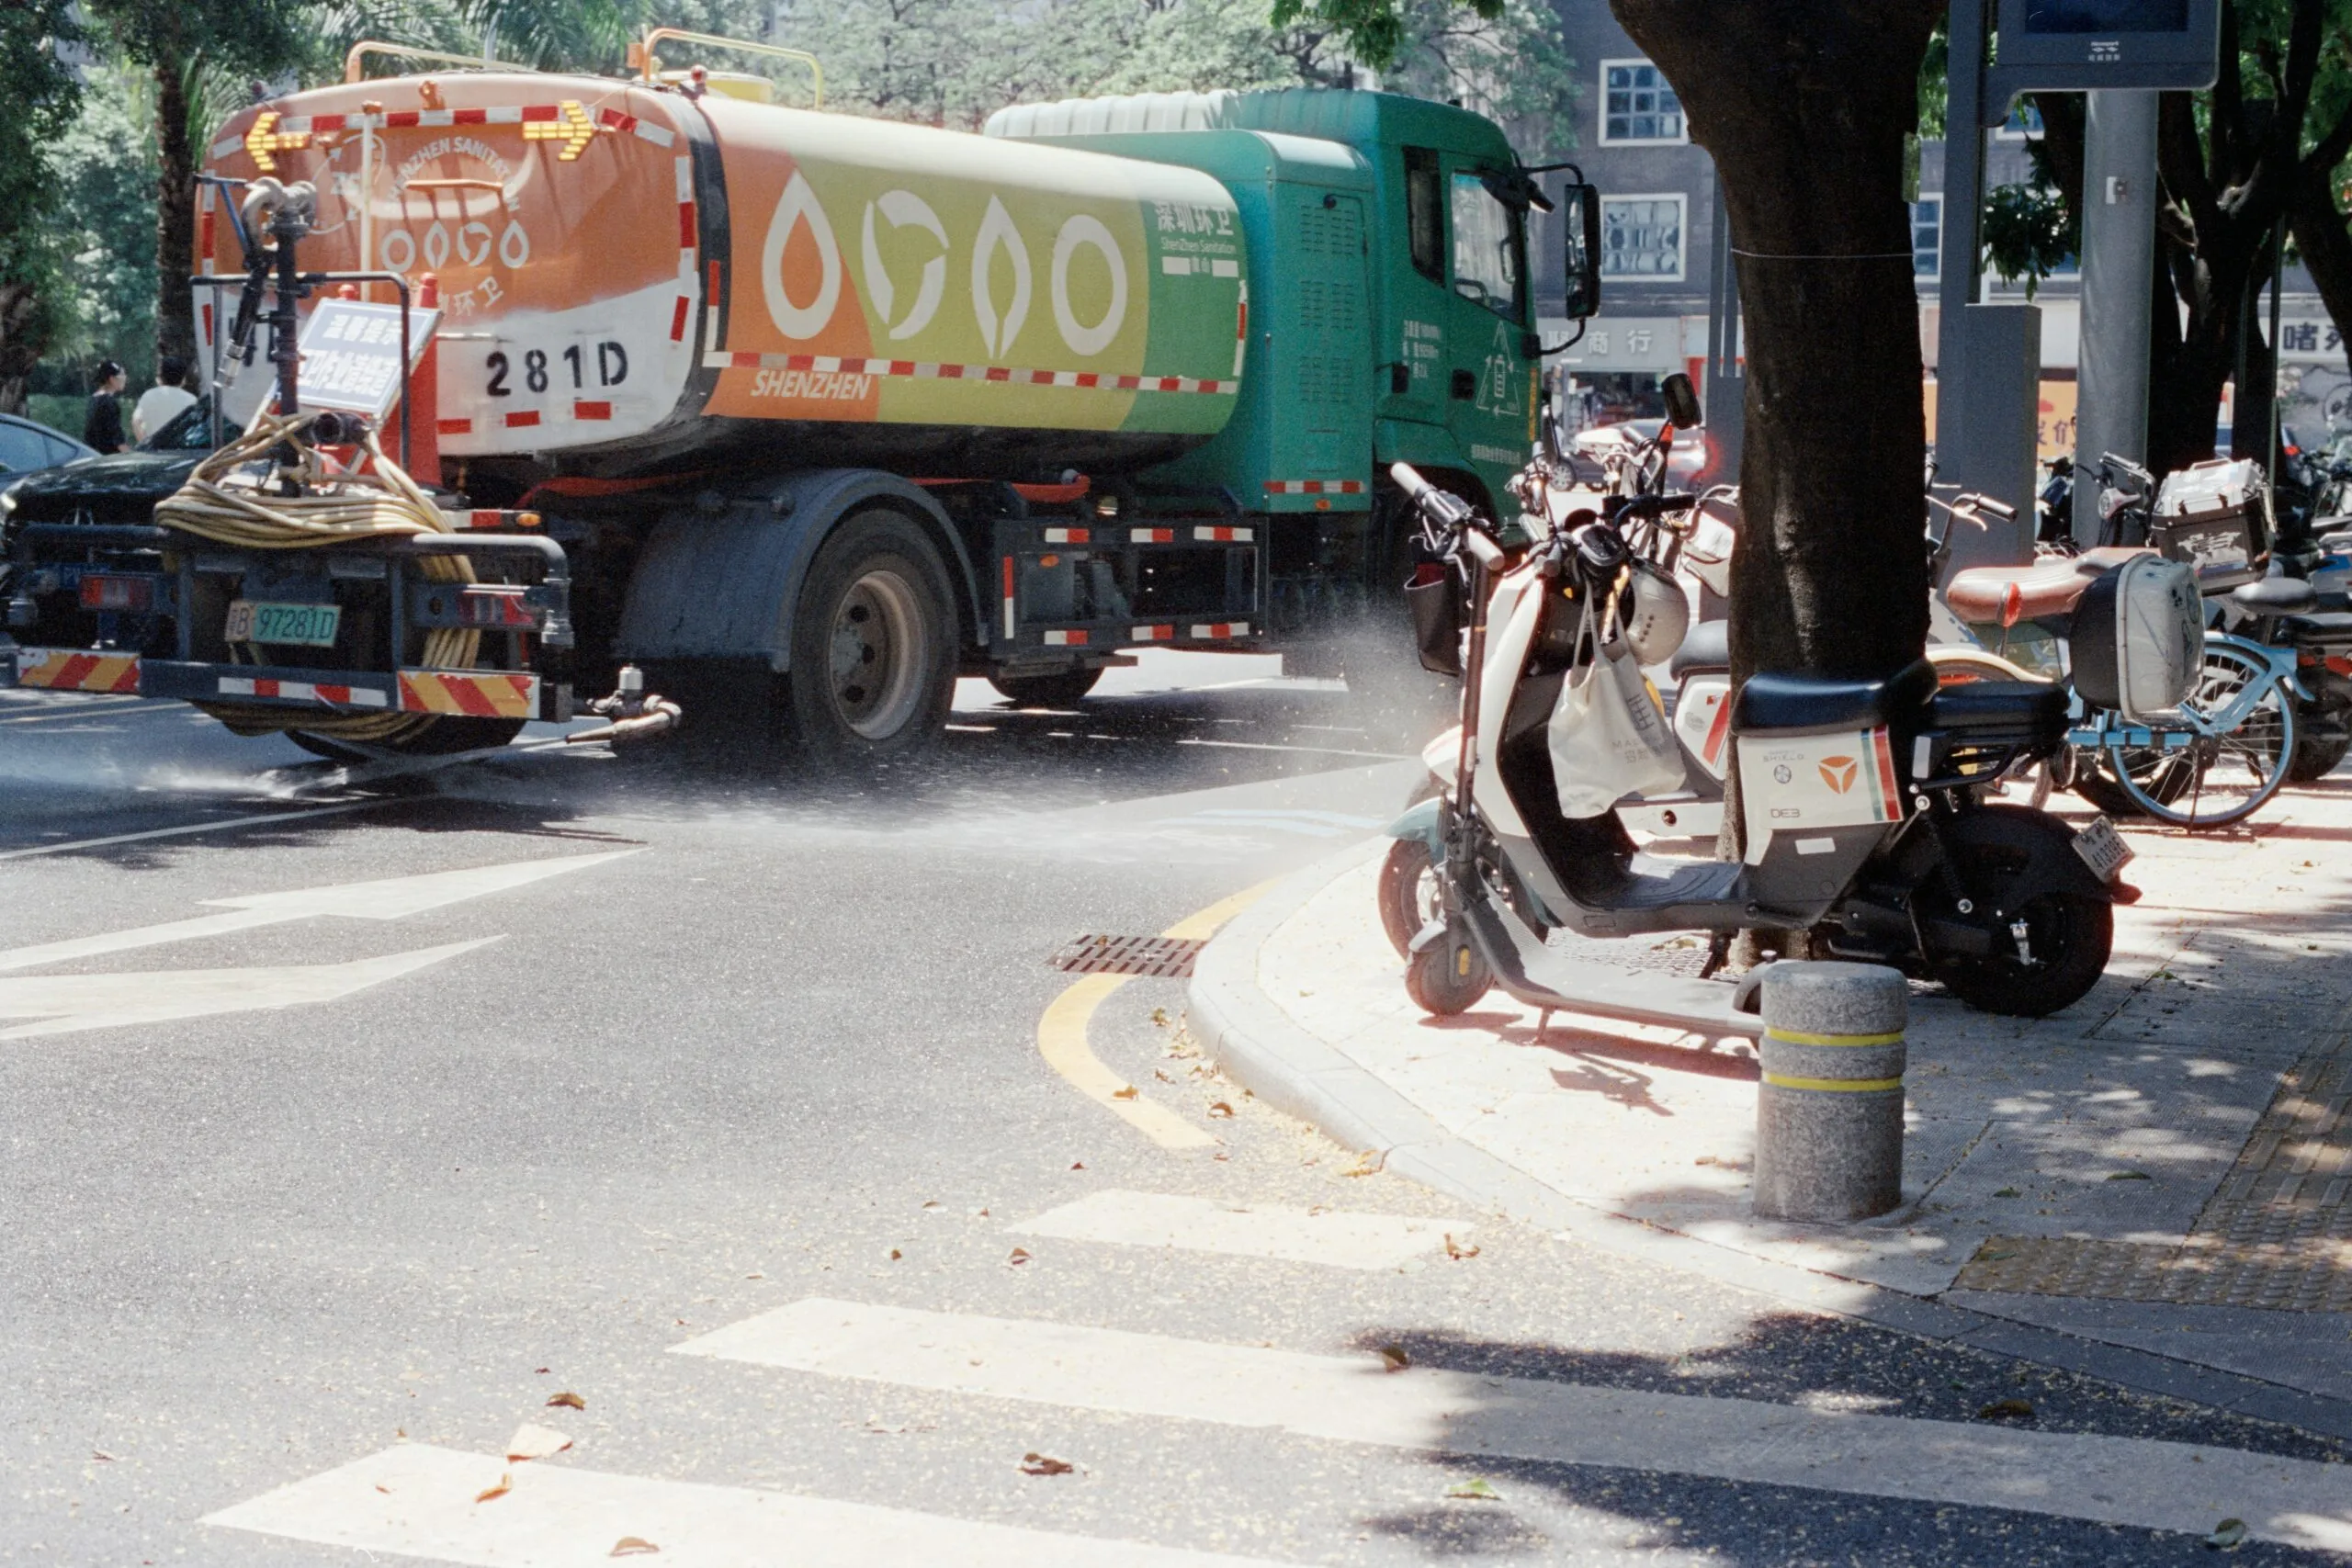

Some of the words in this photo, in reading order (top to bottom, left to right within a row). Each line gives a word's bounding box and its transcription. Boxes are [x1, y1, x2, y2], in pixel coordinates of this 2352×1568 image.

[1155, 201, 1234, 236] 深圳环卫
[486, 341, 628, 397] 281D
[750, 369, 872, 400] SHENZHEN
